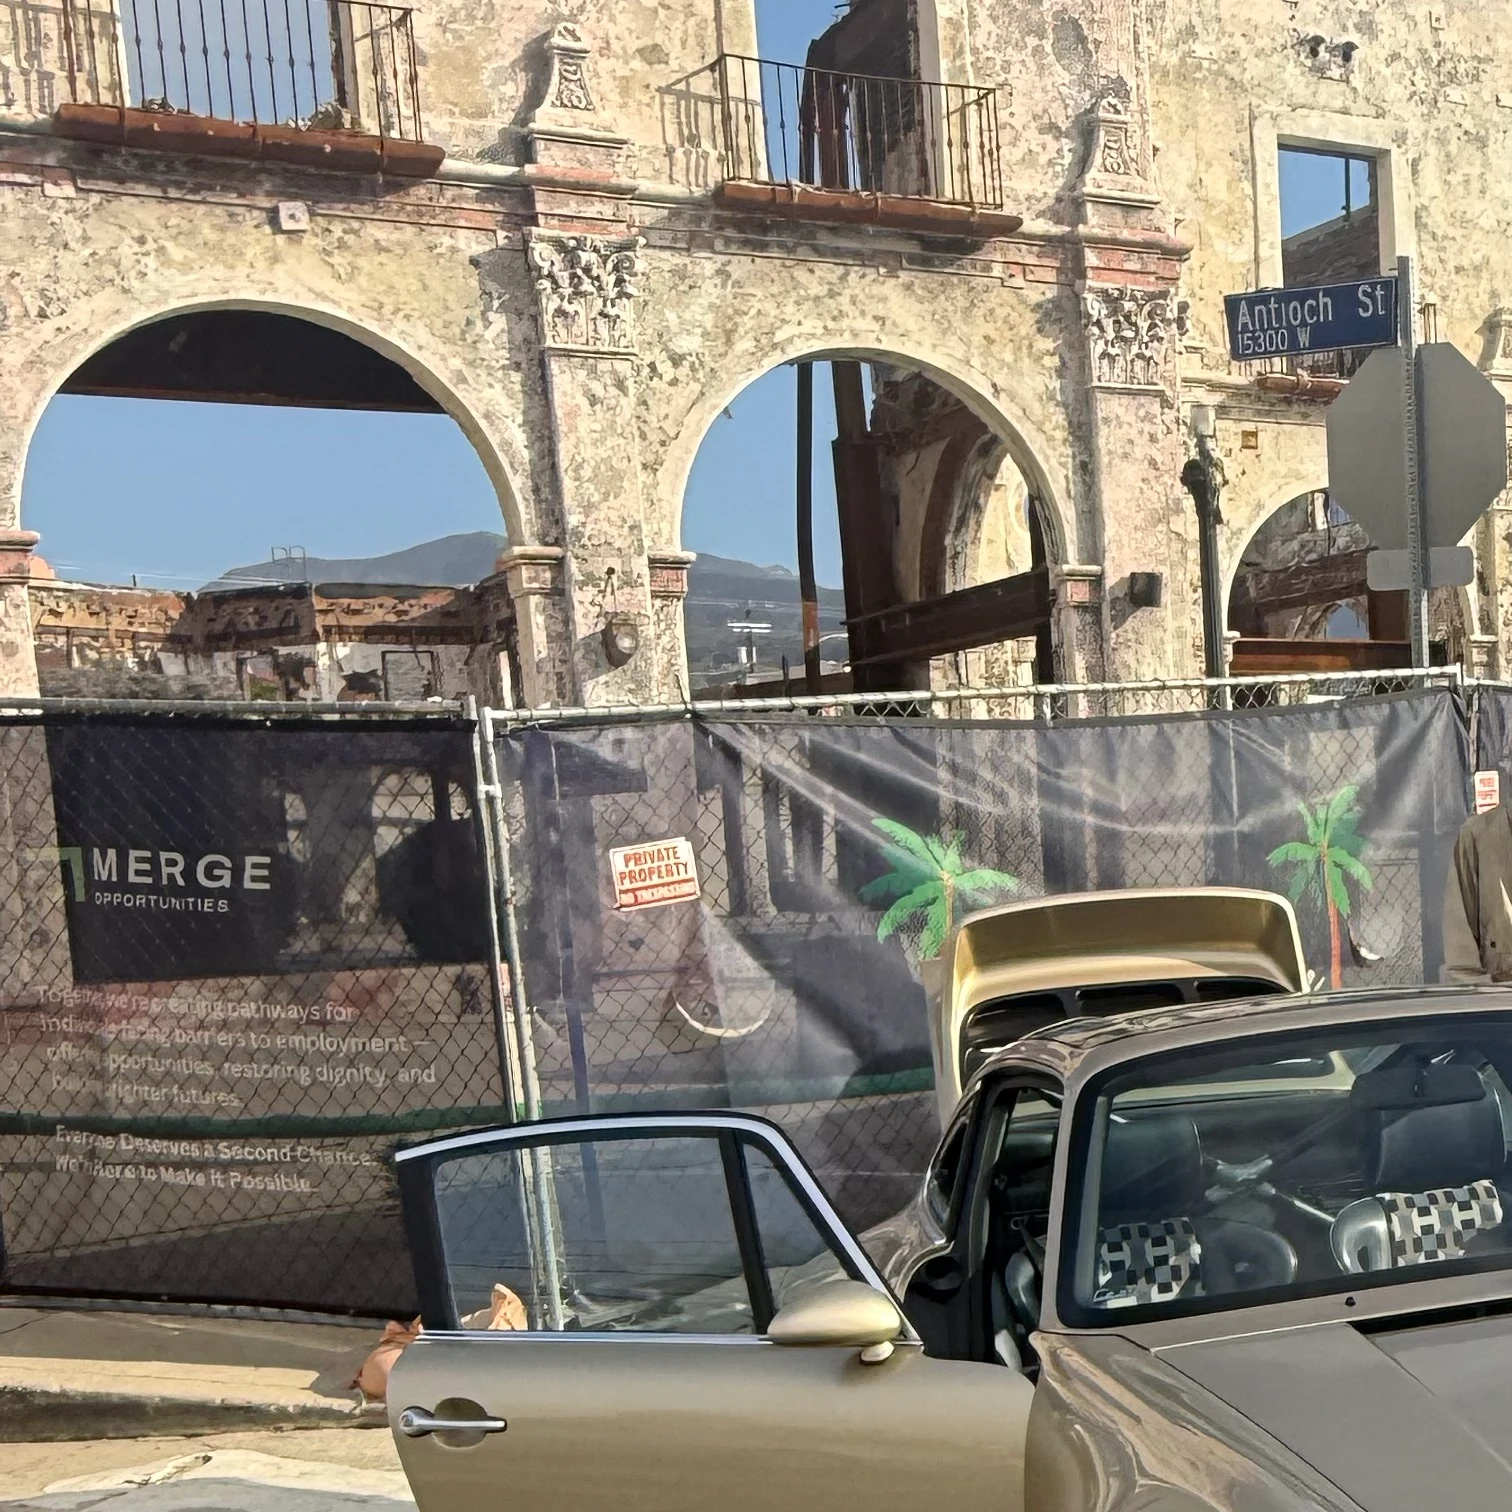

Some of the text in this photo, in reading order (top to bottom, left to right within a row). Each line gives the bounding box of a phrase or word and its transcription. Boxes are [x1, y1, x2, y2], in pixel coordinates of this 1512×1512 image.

[1237, 284, 1386, 331] Antioch St
[1237, 326, 1310, 354] 15300 W
[92, 847, 272, 890] MERGE
[623, 846, 680, 868] PRIVATE
[618, 862, 688, 885] PROPERTY
[94, 891, 230, 913] OPPORTUNITIES
[227, 1000, 320, 1024] pathways
[326, 1001, 356, 1022] for
[250, 1031, 271, 1050] to
[276, 1032, 409, 1058] employment
[223, 1060, 313, 1086] restoring
[398, 1064, 436, 1084] and
[217, 1141, 291, 1162] Second
